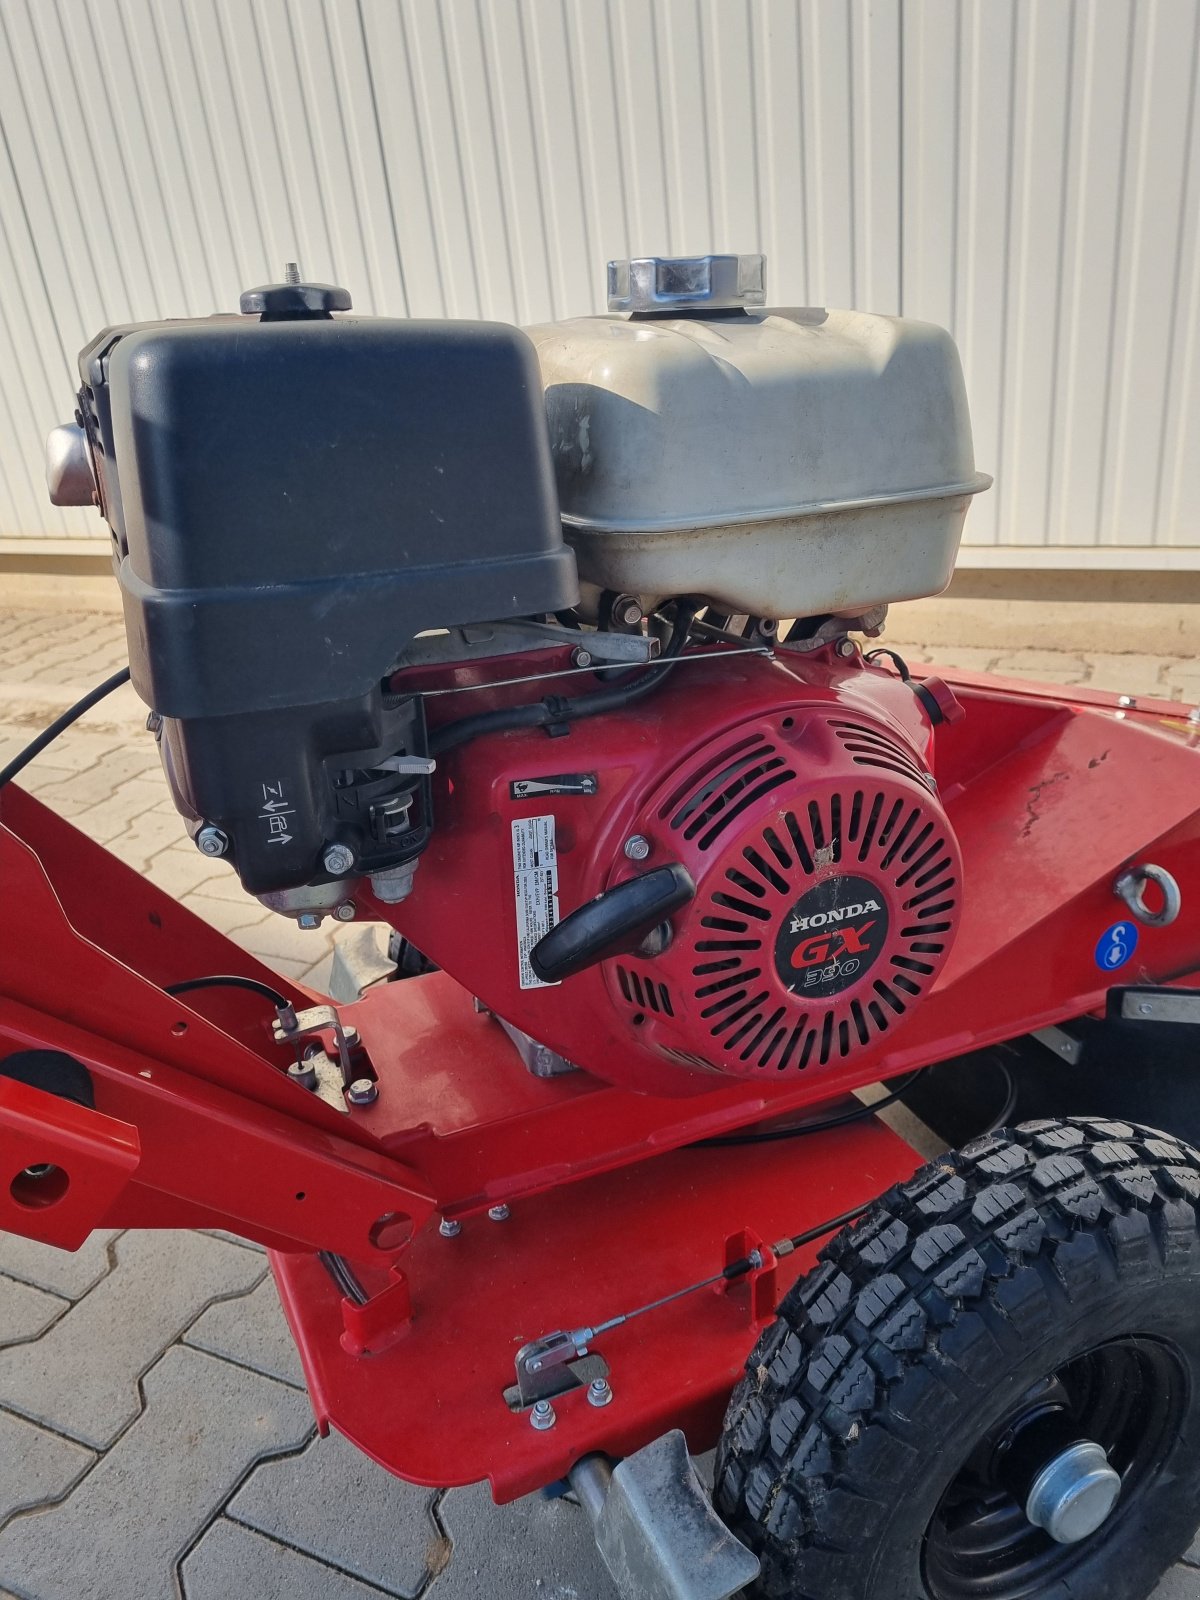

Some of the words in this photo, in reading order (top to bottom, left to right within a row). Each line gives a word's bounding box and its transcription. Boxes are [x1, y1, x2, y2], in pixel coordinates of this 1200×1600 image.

[790, 900, 881, 933] HONDA
[791, 920, 876, 968] GX
[804, 959, 860, 987] 390
